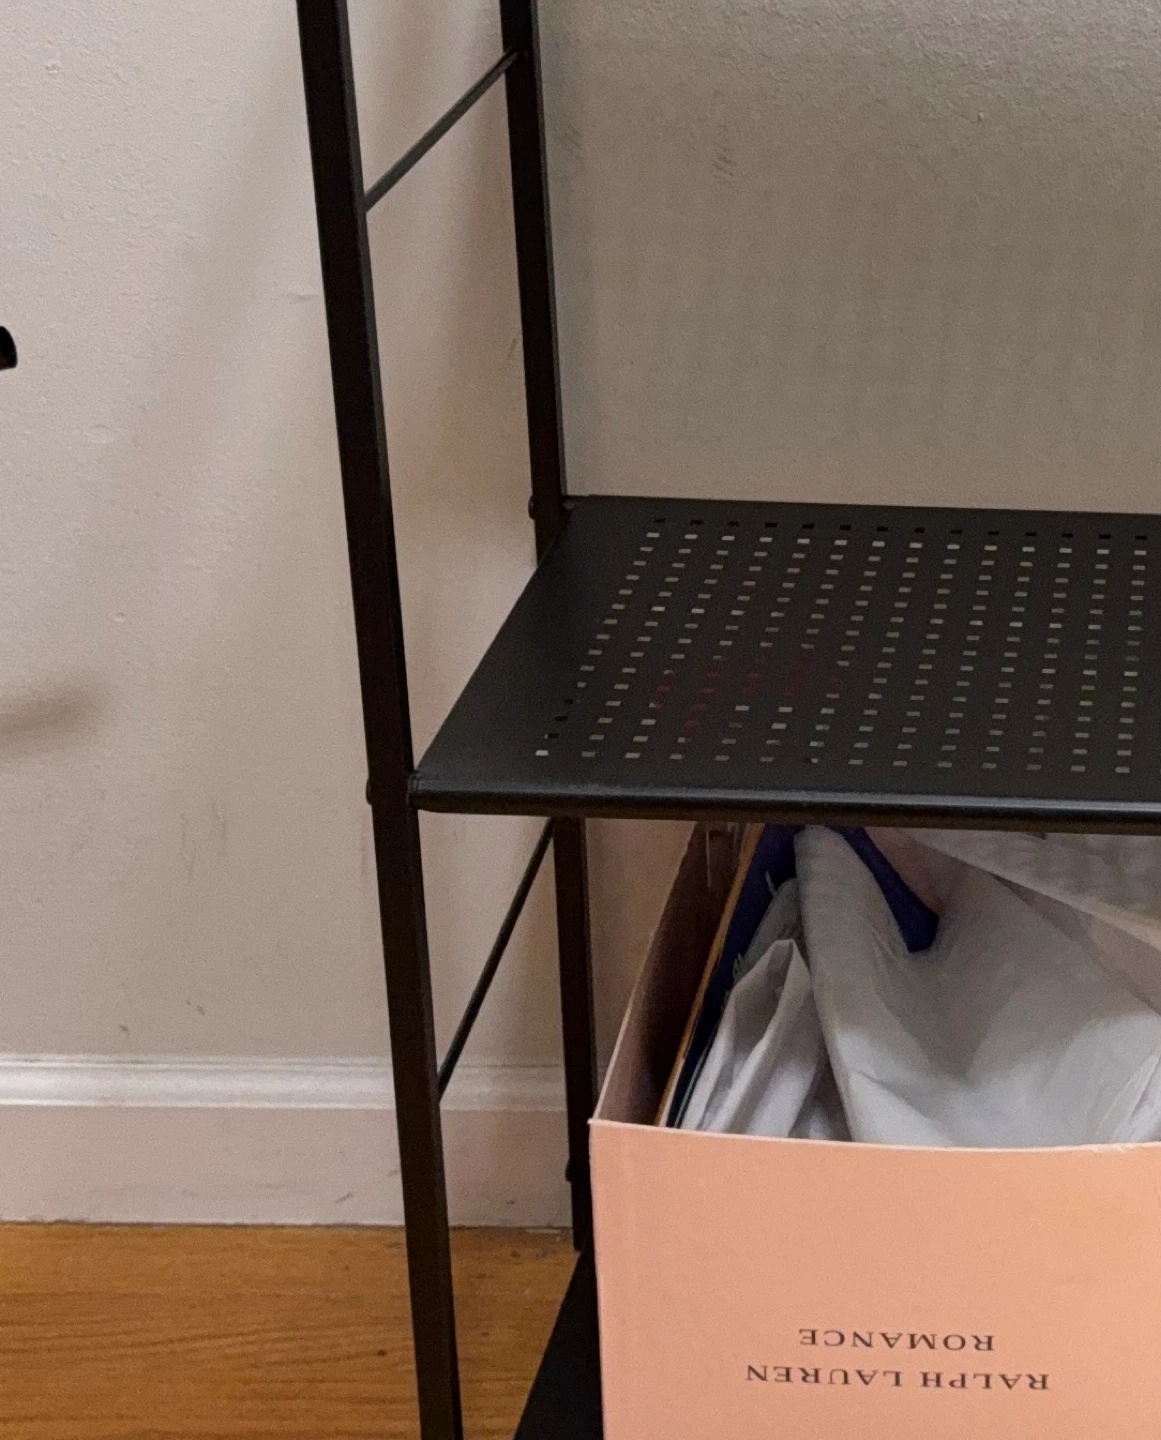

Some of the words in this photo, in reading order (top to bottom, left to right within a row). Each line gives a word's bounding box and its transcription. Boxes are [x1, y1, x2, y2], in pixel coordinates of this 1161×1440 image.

[798, 1328, 995, 1351] ROMANCE
[745, 1364, 903, 1388] LAUREN
[919, 1371, 1049, 1391] RALPH
